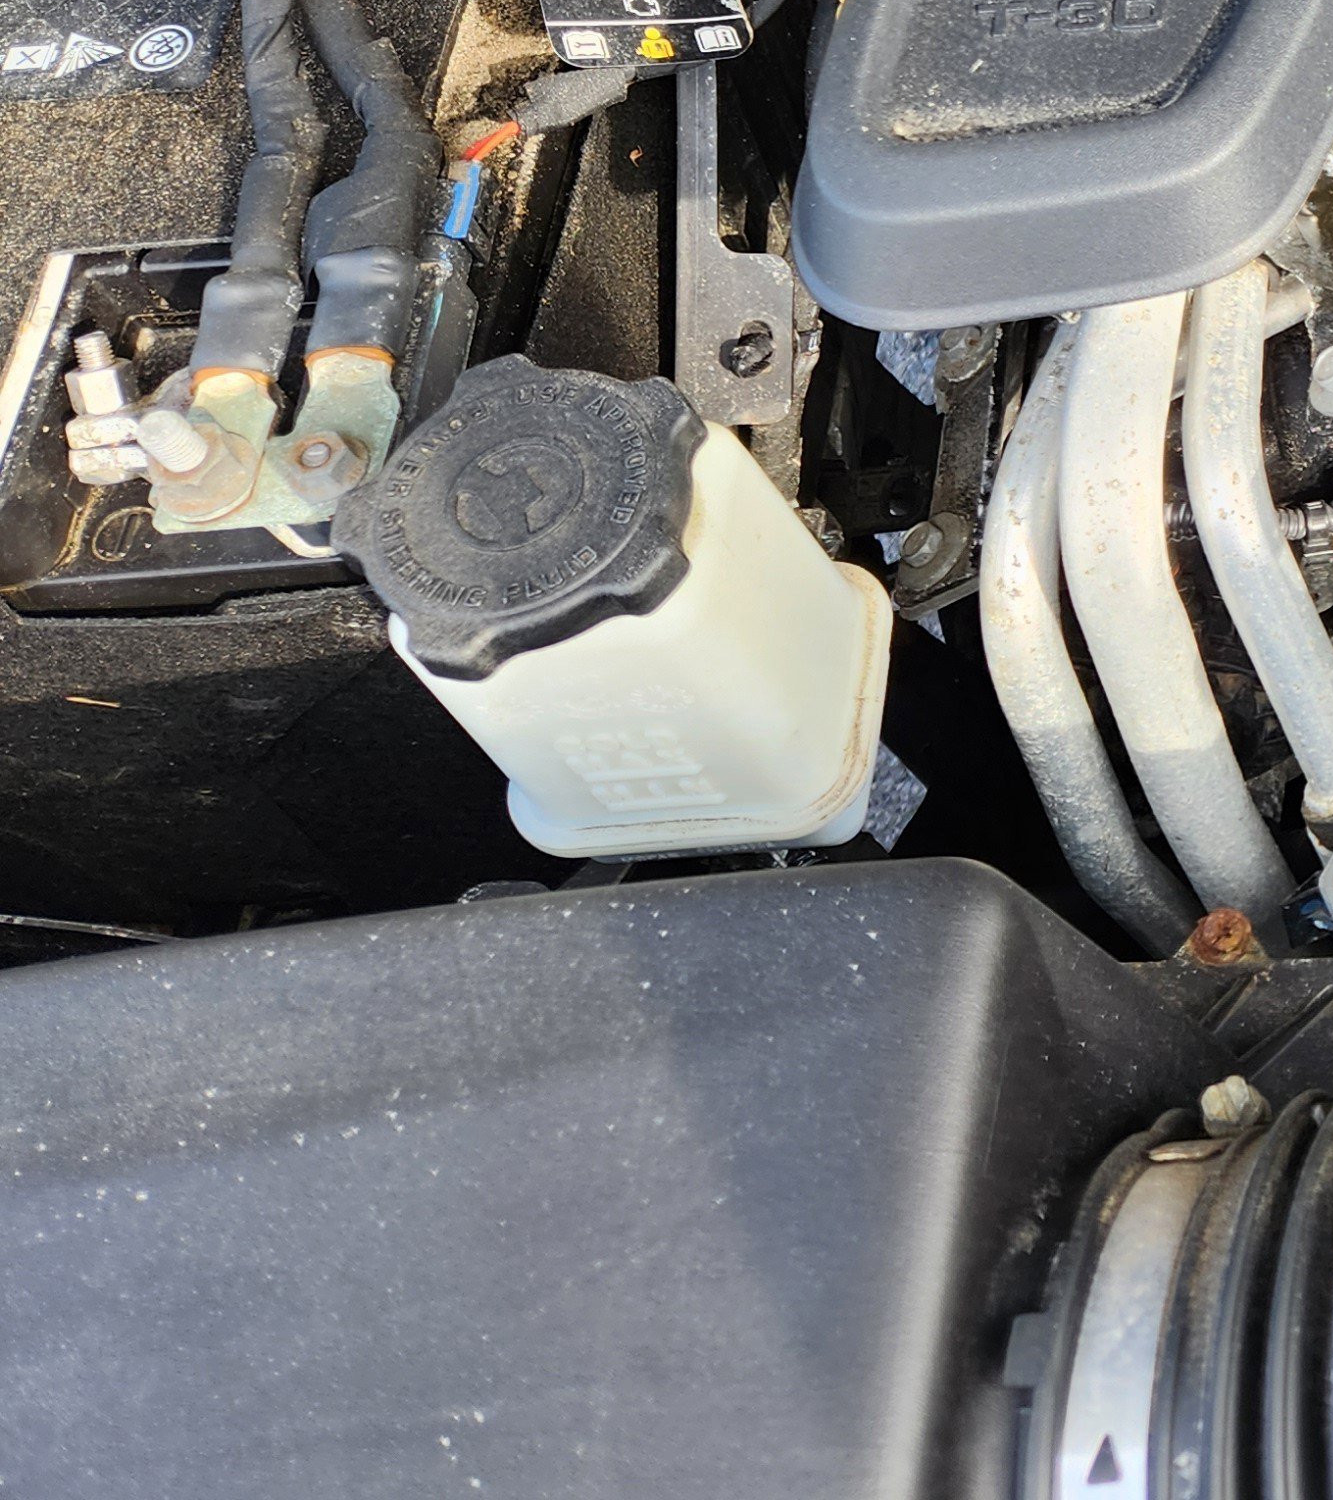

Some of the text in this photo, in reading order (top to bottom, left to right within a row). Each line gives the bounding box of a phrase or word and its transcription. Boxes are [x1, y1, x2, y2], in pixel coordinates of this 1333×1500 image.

[515, 382, 648, 526] USE APPROVED
[379, 506, 488, 608] STEERING
[501, 543, 599, 606] FLUID
